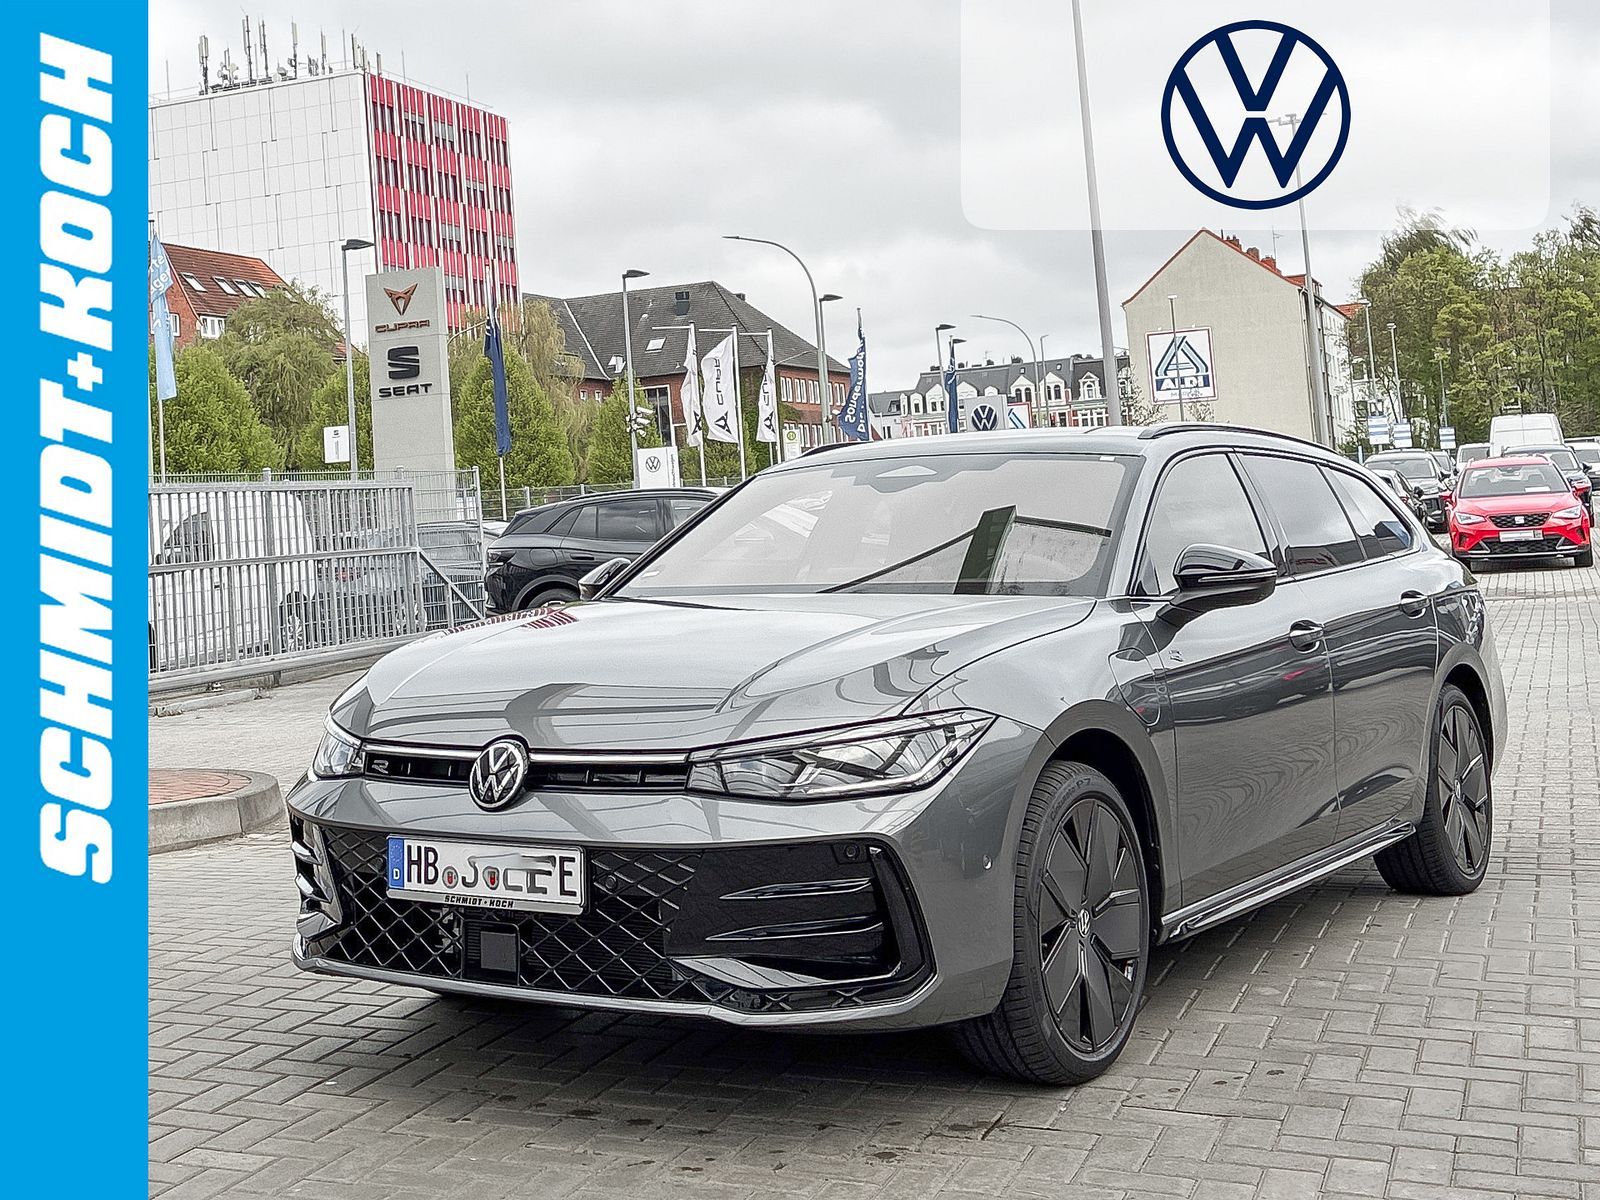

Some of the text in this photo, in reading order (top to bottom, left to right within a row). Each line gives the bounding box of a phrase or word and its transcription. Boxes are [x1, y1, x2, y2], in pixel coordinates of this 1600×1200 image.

[375, 320, 430, 333] CUPRA
[1160, 376, 1204, 390] ALDI
[379, 383, 432, 398] SEAT
[406, 844, 439, 885] HB
[444, 895, 482, 906] SCHMIDT
[489, 899, 514, 908] KOCH
